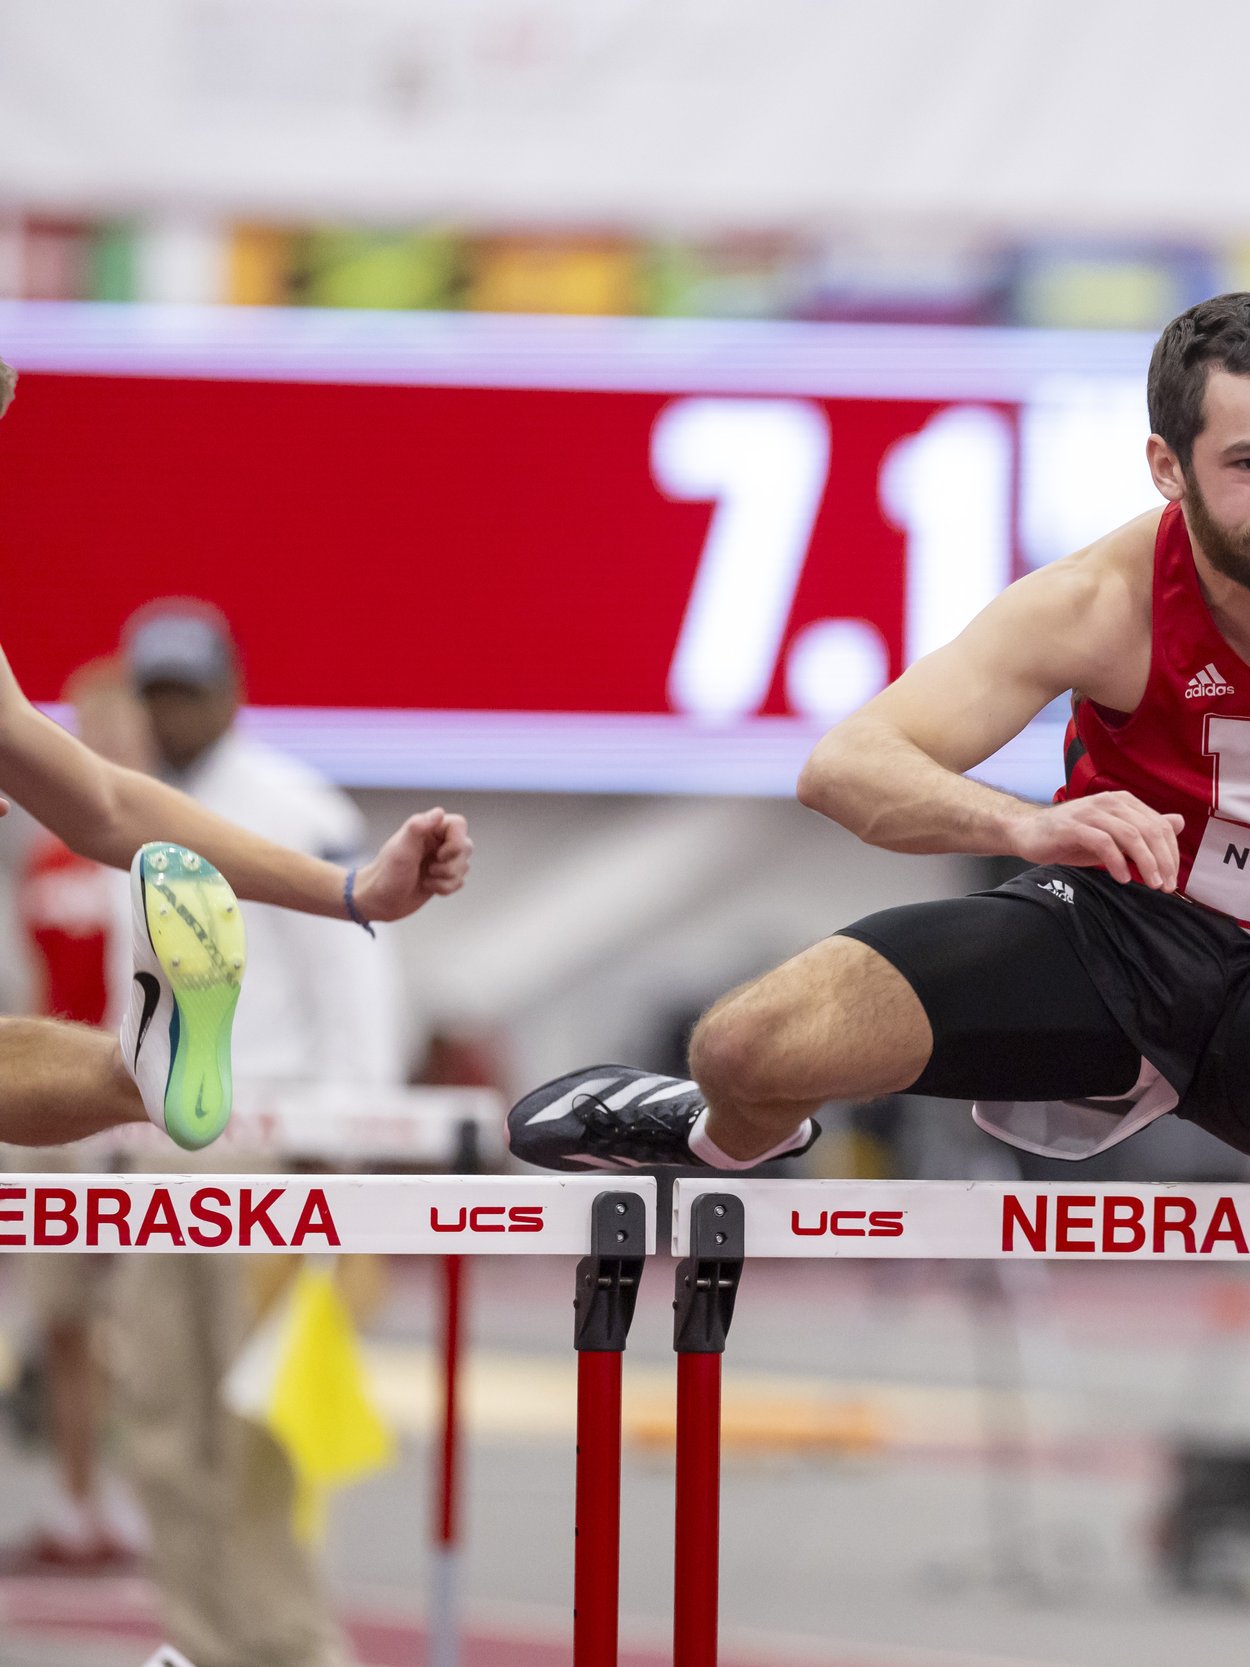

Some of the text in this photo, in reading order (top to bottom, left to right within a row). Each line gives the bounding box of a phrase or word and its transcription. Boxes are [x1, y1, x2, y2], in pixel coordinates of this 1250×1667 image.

[1184, 682, 1235, 699] adidas
[431, 1207, 543, 1232] UCS
[792, 1212, 903, 1236] UCS
